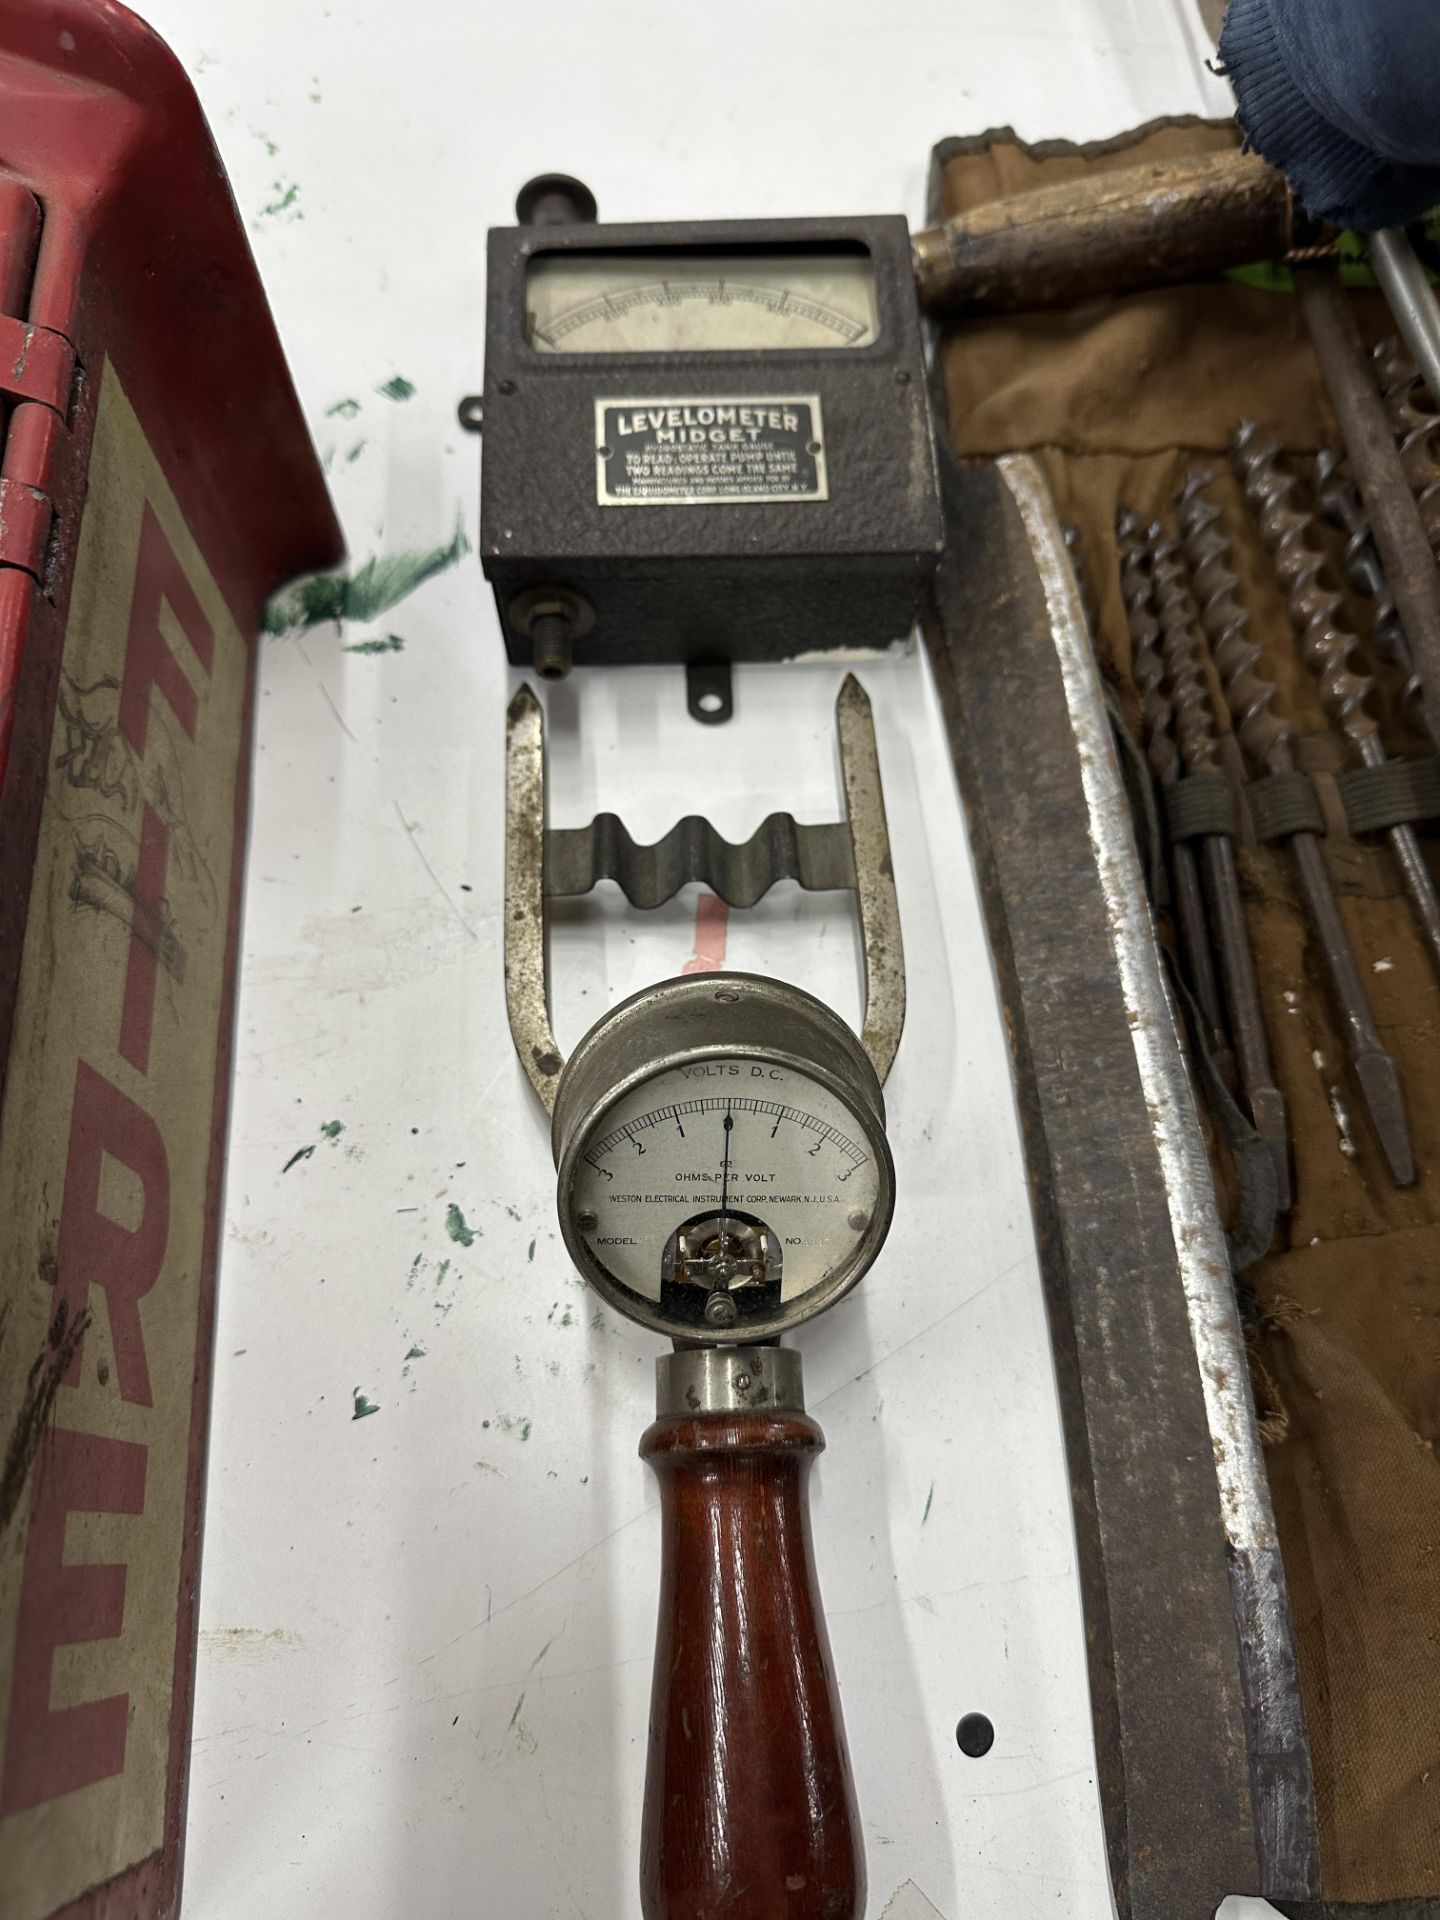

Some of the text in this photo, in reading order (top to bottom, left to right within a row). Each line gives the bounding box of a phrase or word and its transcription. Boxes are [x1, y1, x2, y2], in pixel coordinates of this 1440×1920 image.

[617, 405, 799, 437] LEVELOMETER
[656, 428, 762, 444] MIDGET
[678, 452, 728, 465] OPERATE
[729, 451, 764, 463] PUMP
[765, 450, 797, 463] UNTIL
[626, 462, 798, 477] TWO READINGS COME THE SAME
[680, 1065, 740, 1079] VOLTS
[632, 1142, 822, 1156] 2 2
[0, 498, 216, 1818] FIRE
[598, 1168, 852, 1182] 3 3
[675, 1173, 776, 1181] OHMS PER VOLT
[609, 1194, 642, 1203] WESTON
[645, 1195, 689, 1203] ELECTRICAL
[597, 1237, 638, 1245] MODEL
[785, 1237, 802, 1245] NO
